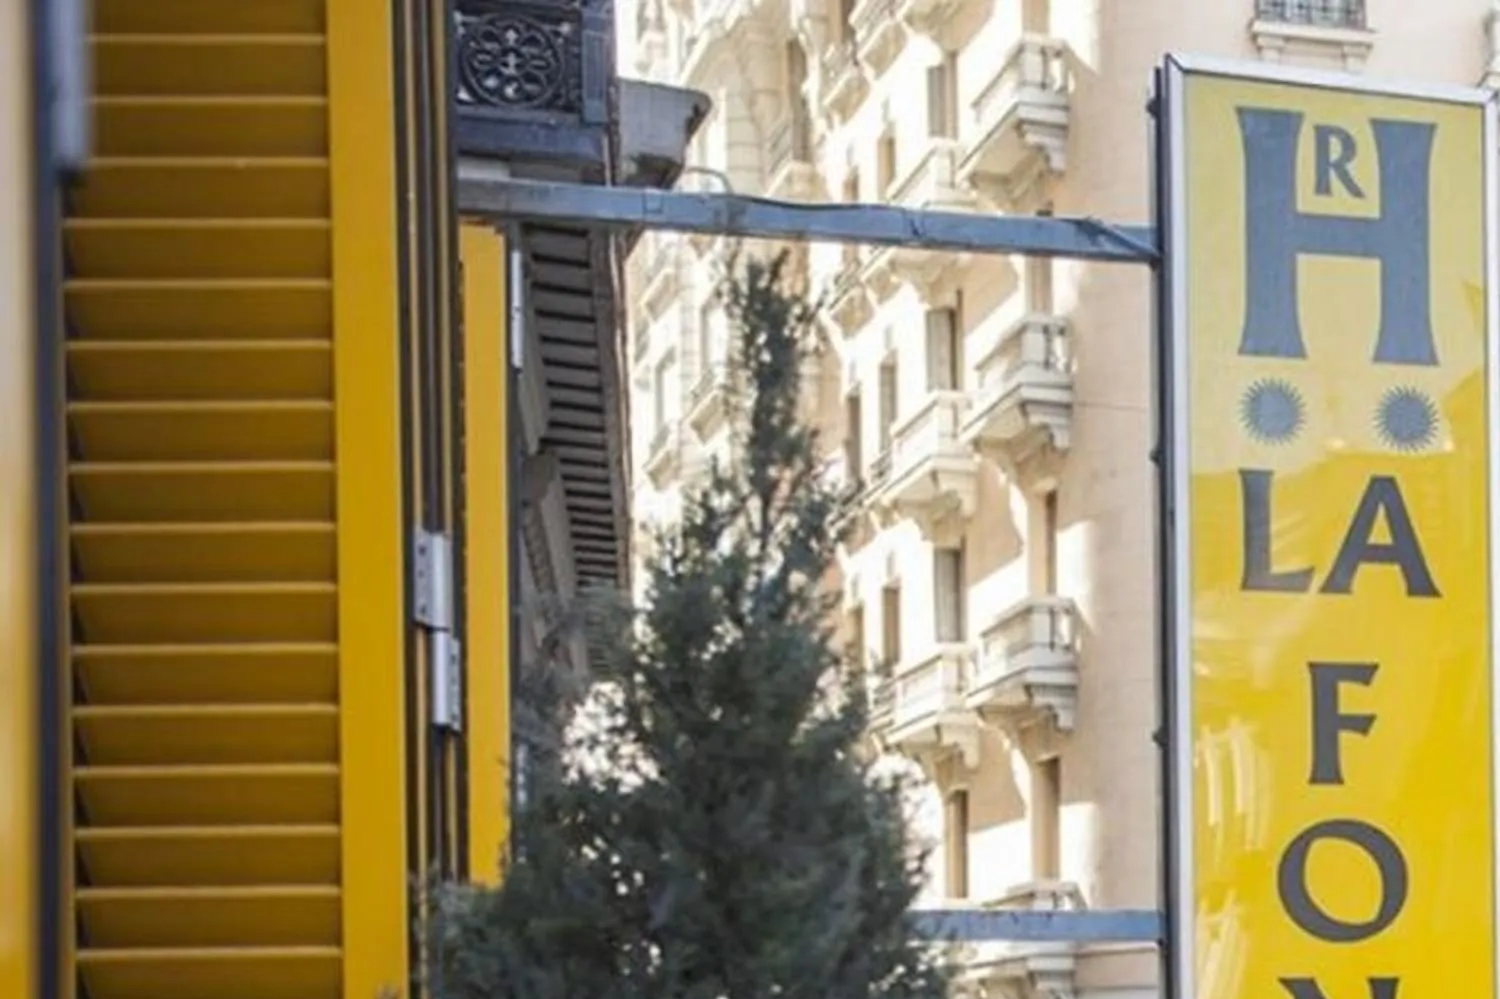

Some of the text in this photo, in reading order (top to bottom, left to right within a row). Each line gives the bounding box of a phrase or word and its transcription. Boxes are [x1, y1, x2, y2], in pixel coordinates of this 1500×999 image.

[1313, 123, 1366, 199] R
[1235, 106, 1439, 366] H
[1238, 467, 1442, 599] LA
